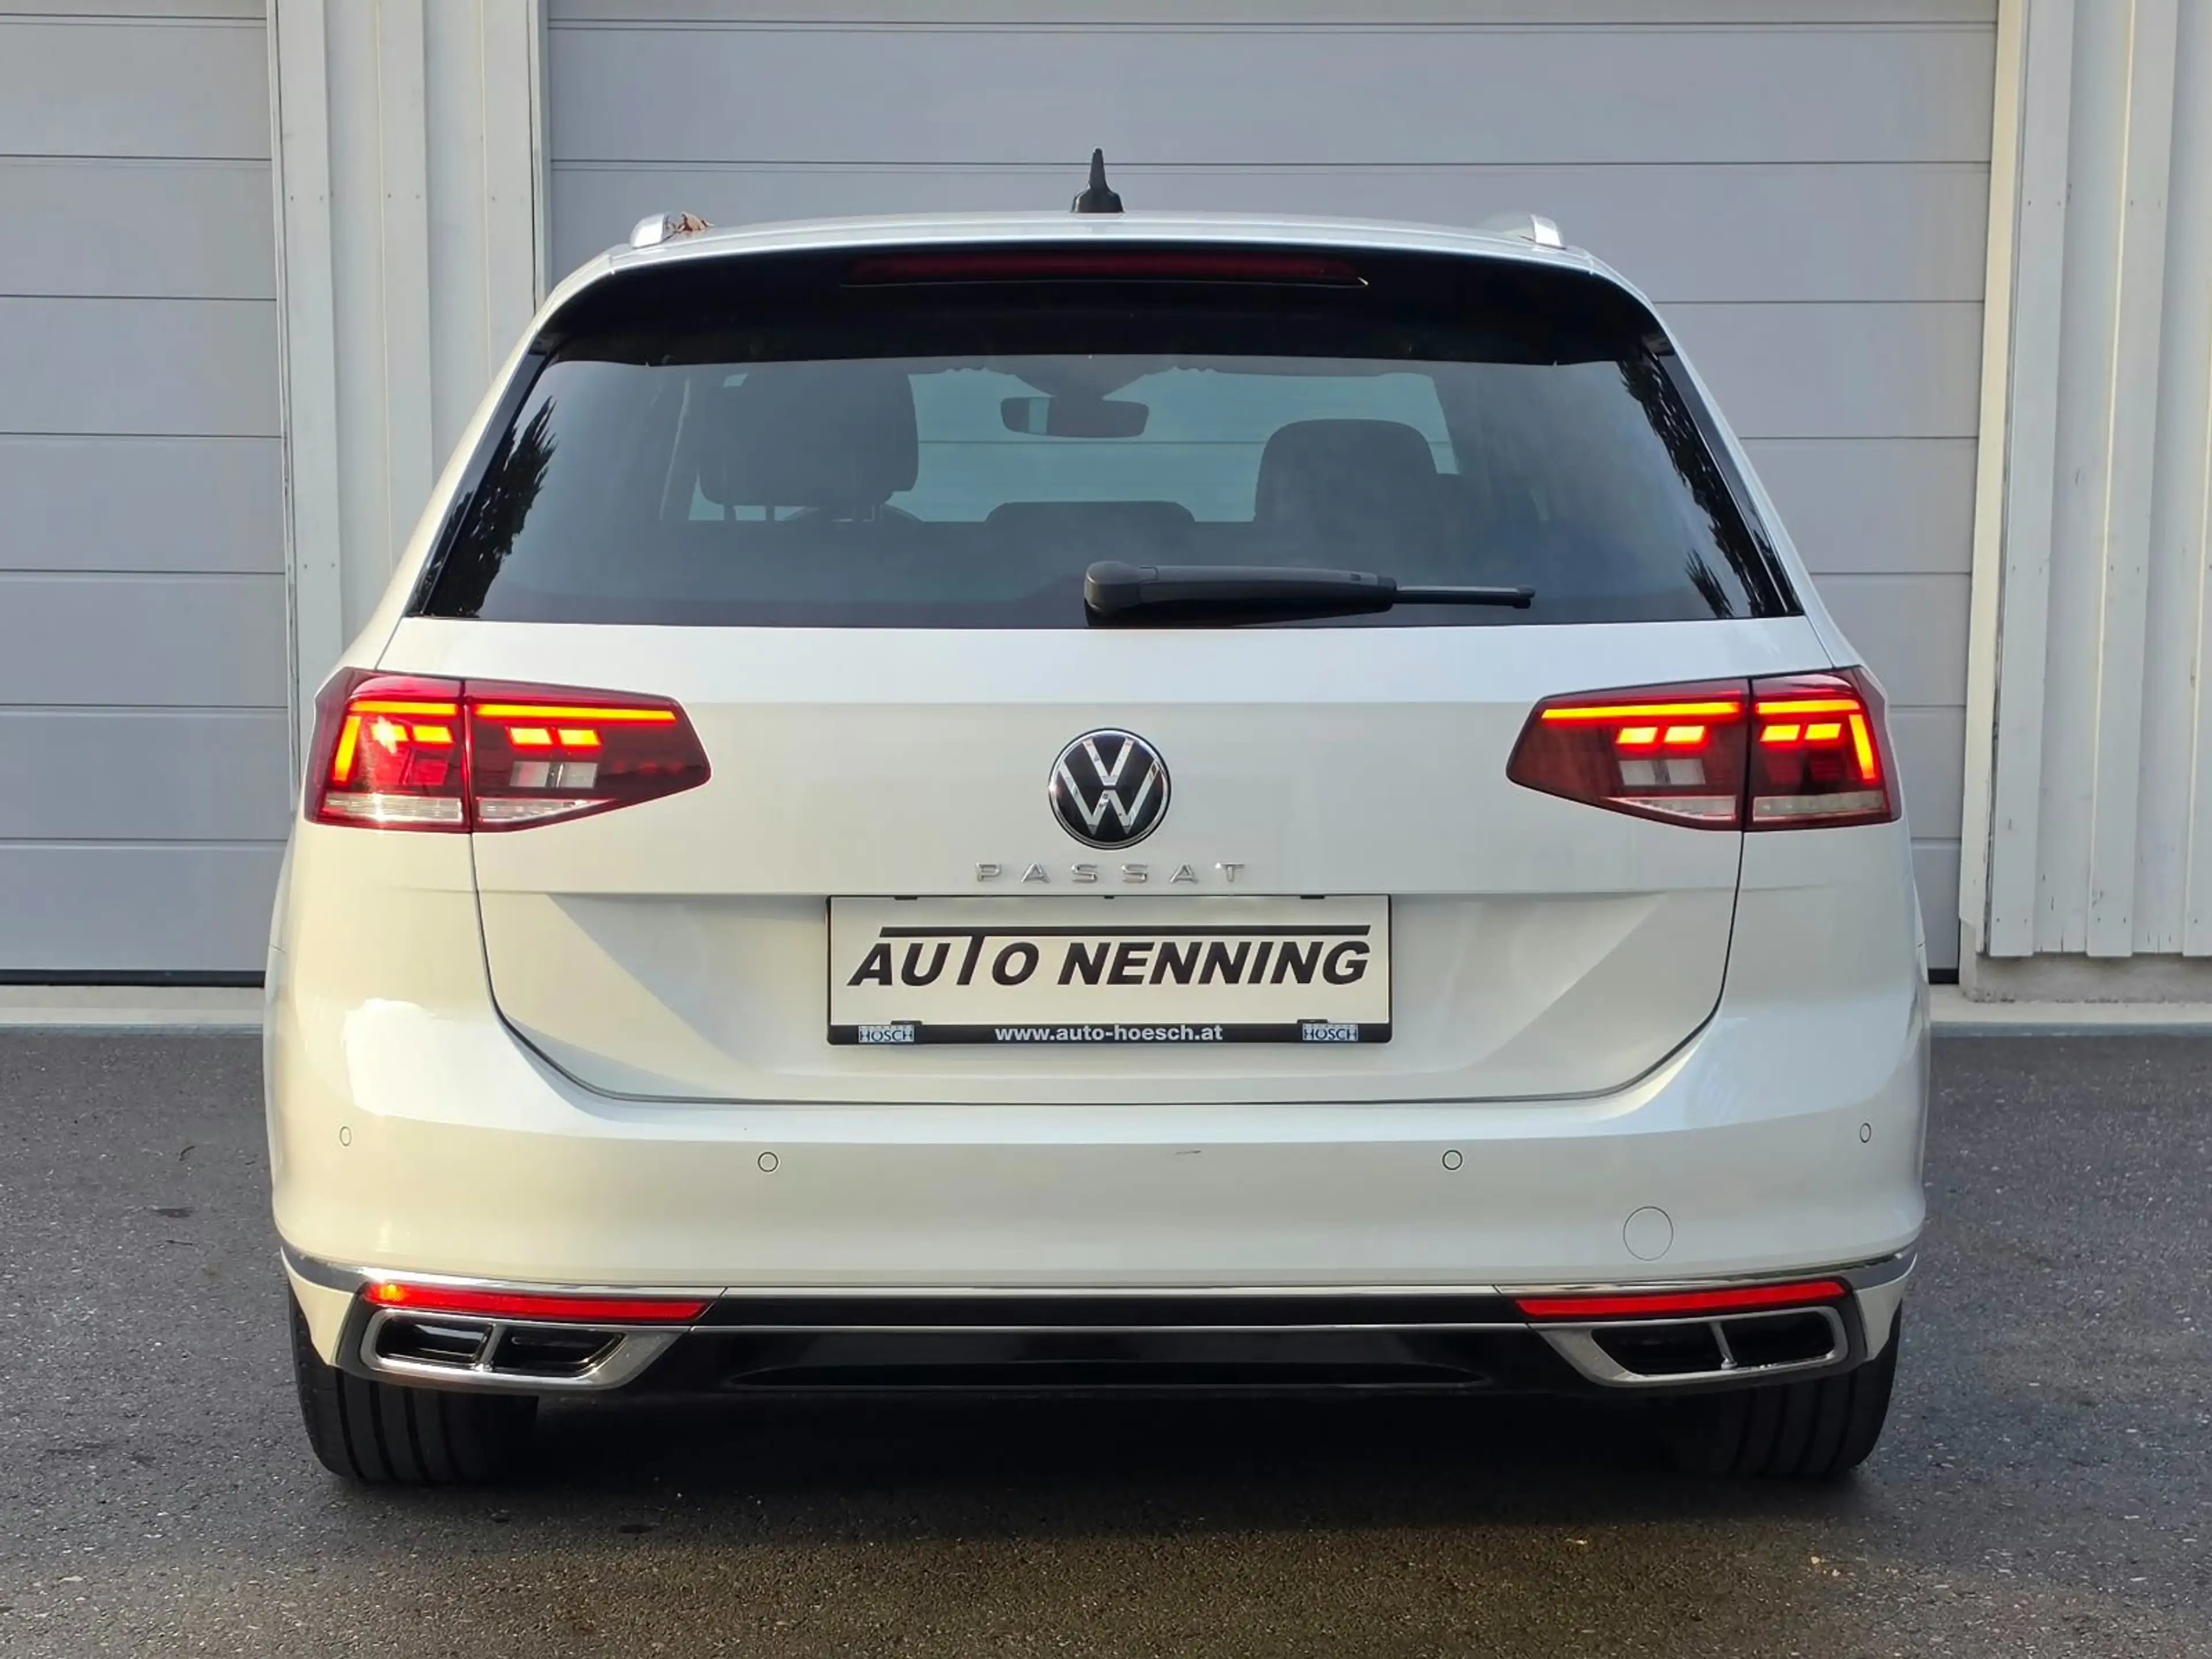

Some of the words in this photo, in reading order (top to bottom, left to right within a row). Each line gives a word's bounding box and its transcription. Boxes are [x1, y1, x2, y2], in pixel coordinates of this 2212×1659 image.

[1058, 736, 1159, 835] VW
[975, 862, 1244, 883] PASSAT
[847, 927, 1039, 986] AUTO
[1057, 941, 1370, 985] NENNING
[995, 1024, 1222, 1040] www.auto-hoesch.at
